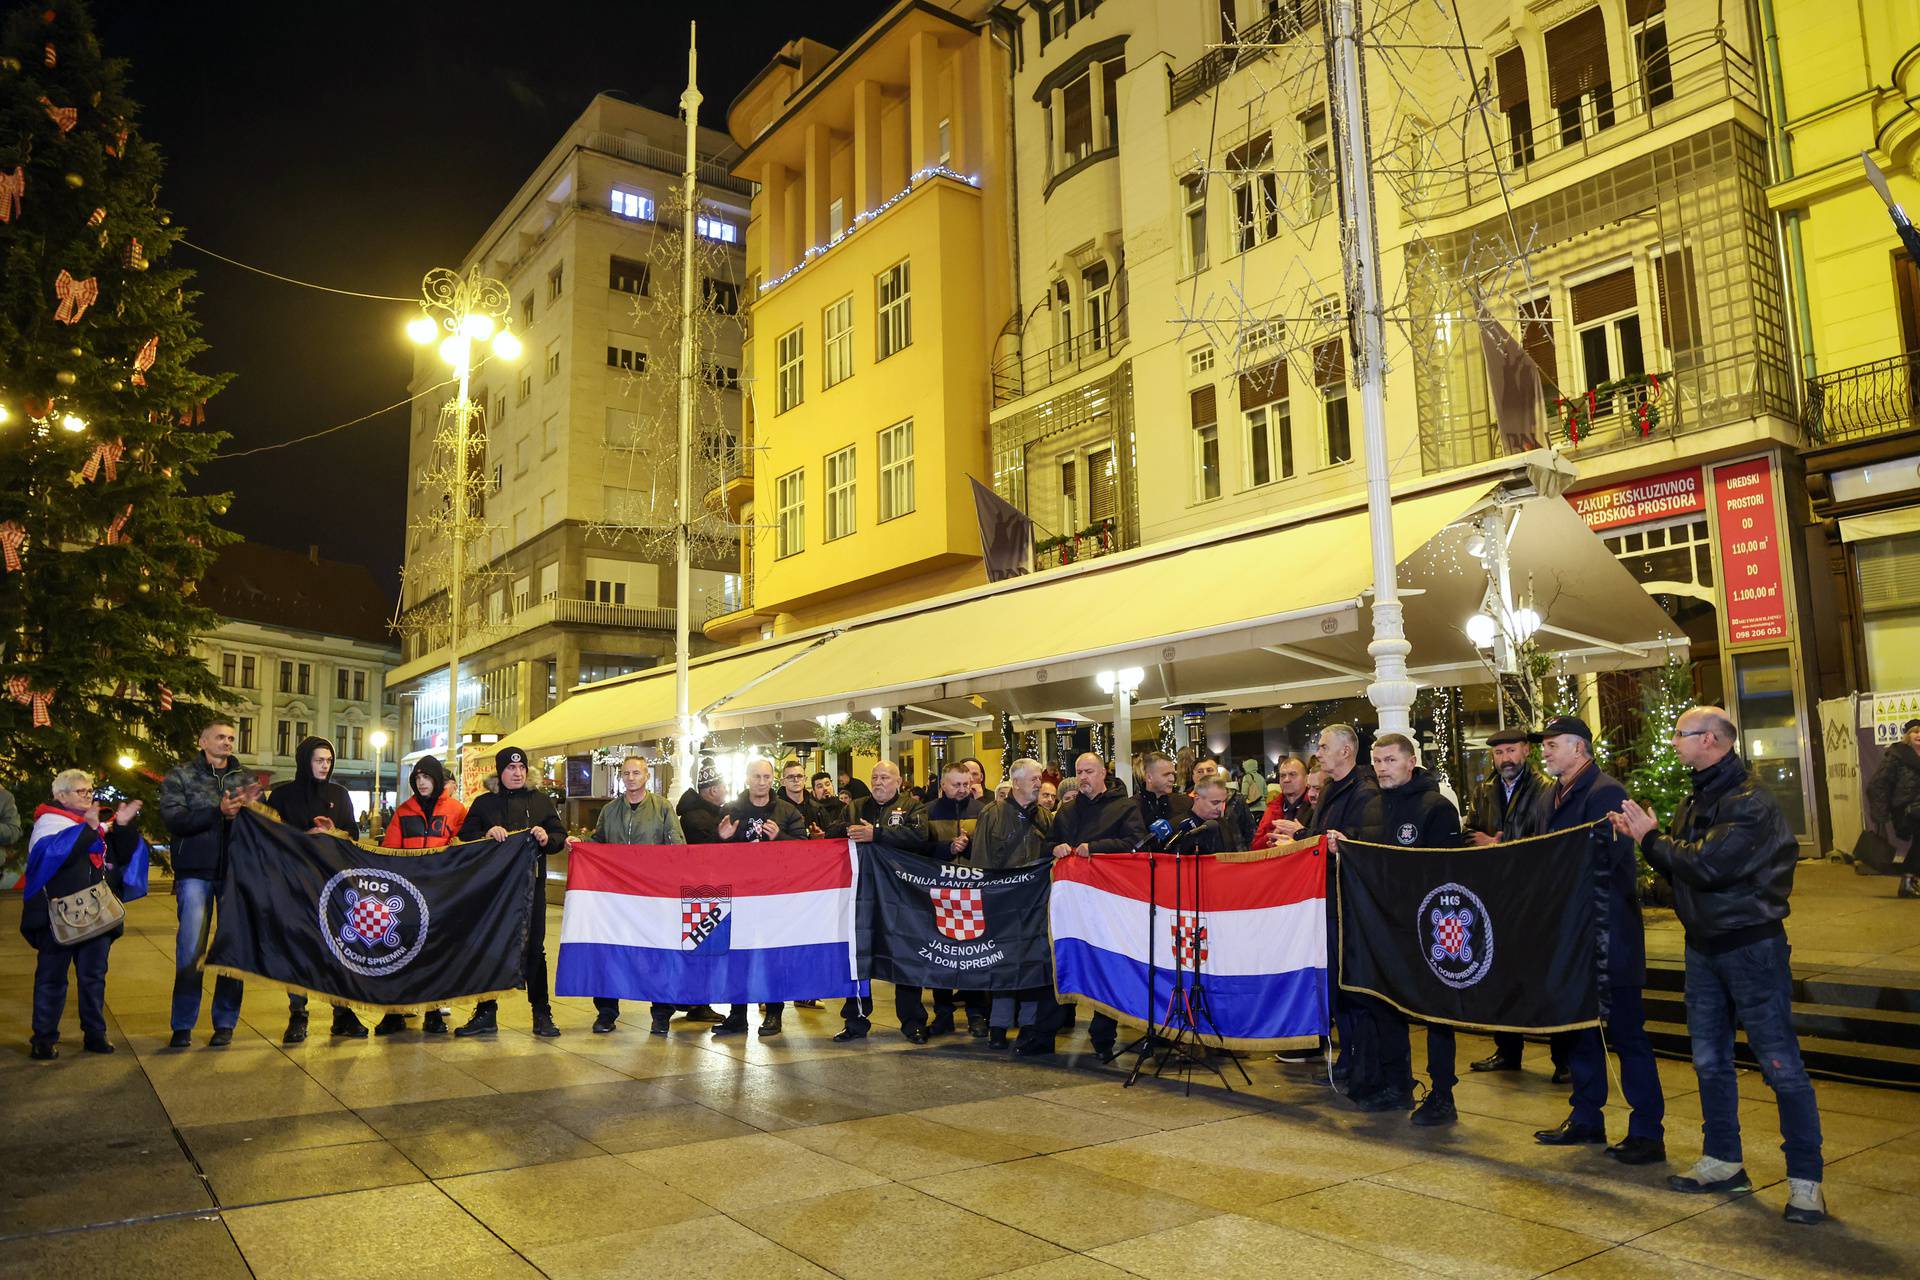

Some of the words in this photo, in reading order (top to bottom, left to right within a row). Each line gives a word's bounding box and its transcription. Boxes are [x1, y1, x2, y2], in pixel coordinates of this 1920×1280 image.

[1727, 473, 1760, 490] UREDSKI
[1577, 495, 1611, 514] ZAKUP
[1613, 477, 1695, 506] EKSKLUZIVNOG
[1727, 493, 1764, 511] PROSTORI
[1638, 493, 1696, 516] PROSTORA
[1742, 517, 1753, 529] OD
[1732, 540, 1758, 555] 110,00
[1644, 561, 1653, 574] 5
[1747, 564, 1758, 576] DO
[1733, 586, 1767, 602] 1.100,00
[895, 870, 937, 886] SATNIJA
[940, 865, 984, 880] HOS
[358, 879, 389, 893] HOS
[689, 907, 721, 947] HSP
[344, 948, 366, 964] DOM
[367, 946, 407, 965] SPREMNI
[928, 939, 996, 956] JASENOVAC
[918, 947, 933, 961] ZA
[934, 956, 957, 969] DOM
[960, 950, 1004, 970] SPREMNI
